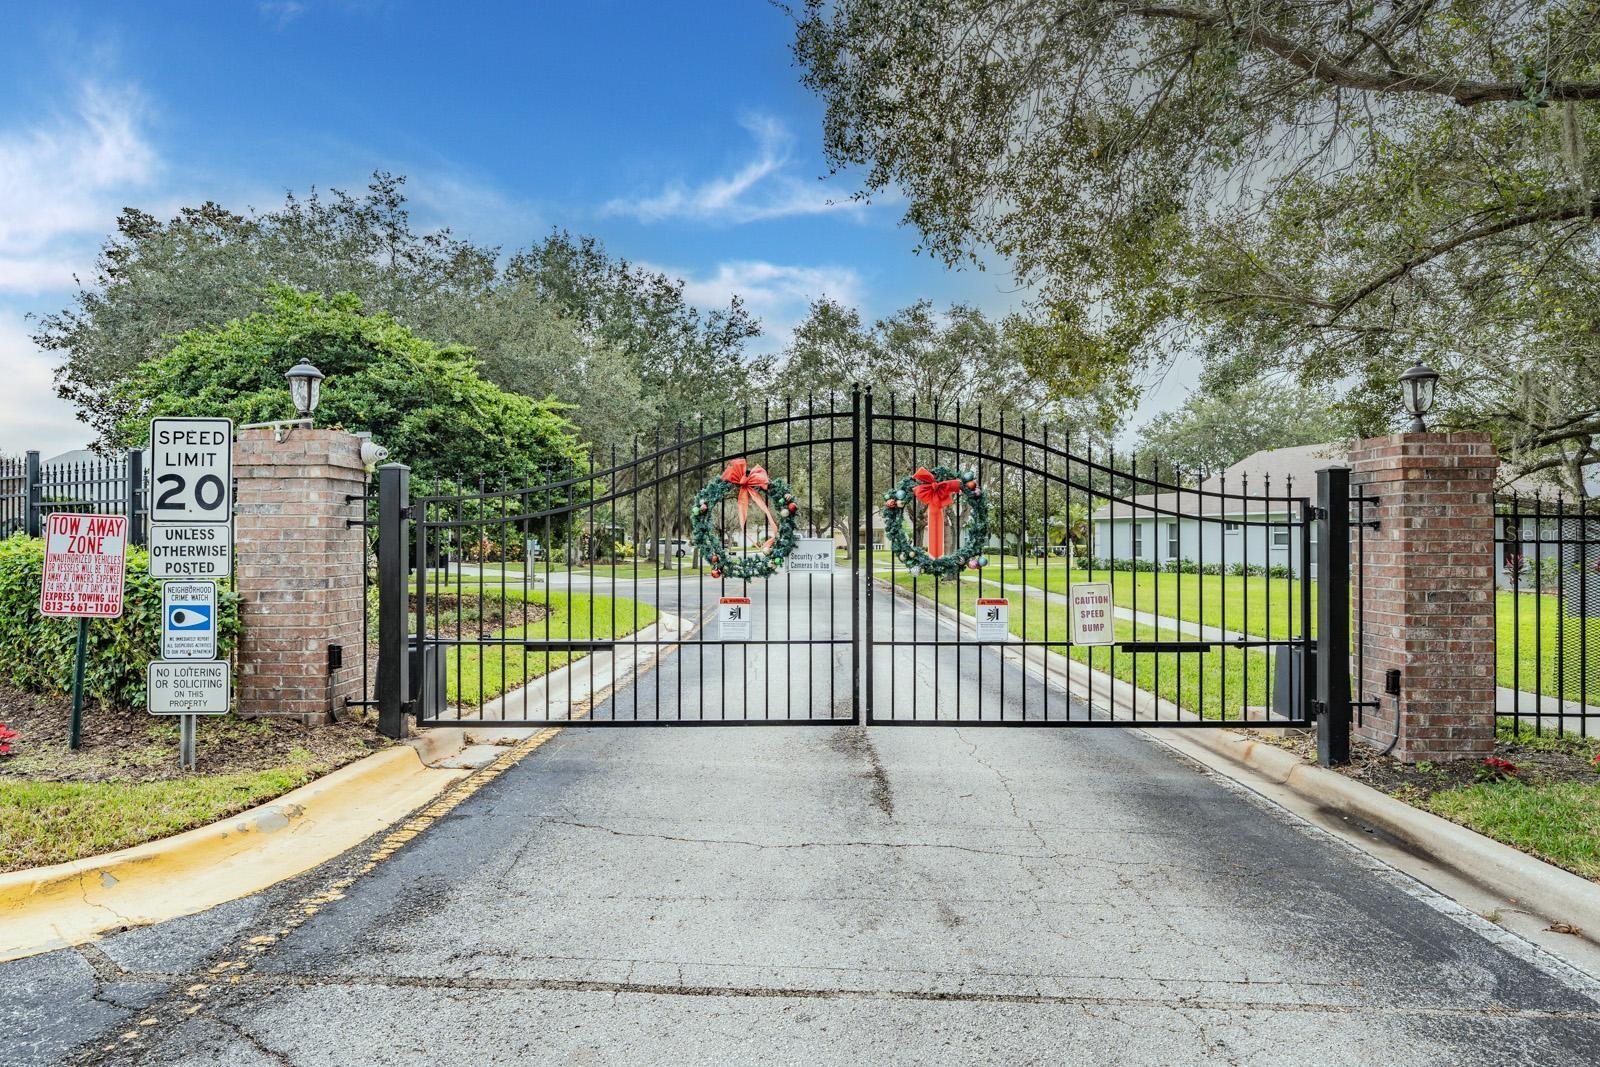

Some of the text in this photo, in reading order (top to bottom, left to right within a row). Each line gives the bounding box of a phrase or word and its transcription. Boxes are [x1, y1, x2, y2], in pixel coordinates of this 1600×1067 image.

[158, 430, 225, 446] SPEED
[166, 452, 217, 467] LIMIT
[156, 473, 225, 511] 20
[53, 517, 123, 537] TOW AWAY
[165, 528, 215, 541] UNLESS
[68, 536, 104, 554] ZONE
[153, 545, 227, 557] OTHERWISE
[790, 552, 813, 561] Security
[49, 554, 121, 565] UNAUTHORIZED VEHICLES
[790, 561, 813, 569] Cameras
[820, 561, 830, 569] Use
[48, 563, 120, 575] OR VESSELS WILL BE TOWED
[165, 562, 215, 574] POSTED
[48, 572, 120, 584] AWAY AT OWNERS EXPENSE
[47, 582, 54, 591] 24
[56, 582, 66, 592] HRS
[74, 583, 84, 592] DAY
[90, 584, 103, 593] DAYS
[110, 585, 118, 594] WK
[167, 586, 212, 594] NEIGHBORHOOD
[45, 592, 119, 603] EXPRESS TOWING LLC
[1074, 596, 1108, 604] CAUTION
[44, 601, 118, 612] 813-661-1100
[1080, 610, 1104, 618] SPEED
[1082, 623, 1105, 632] BUMP
[156, 668, 222, 678] NO LOITERING
[156, 679, 222, 688] OR SOLICITING
